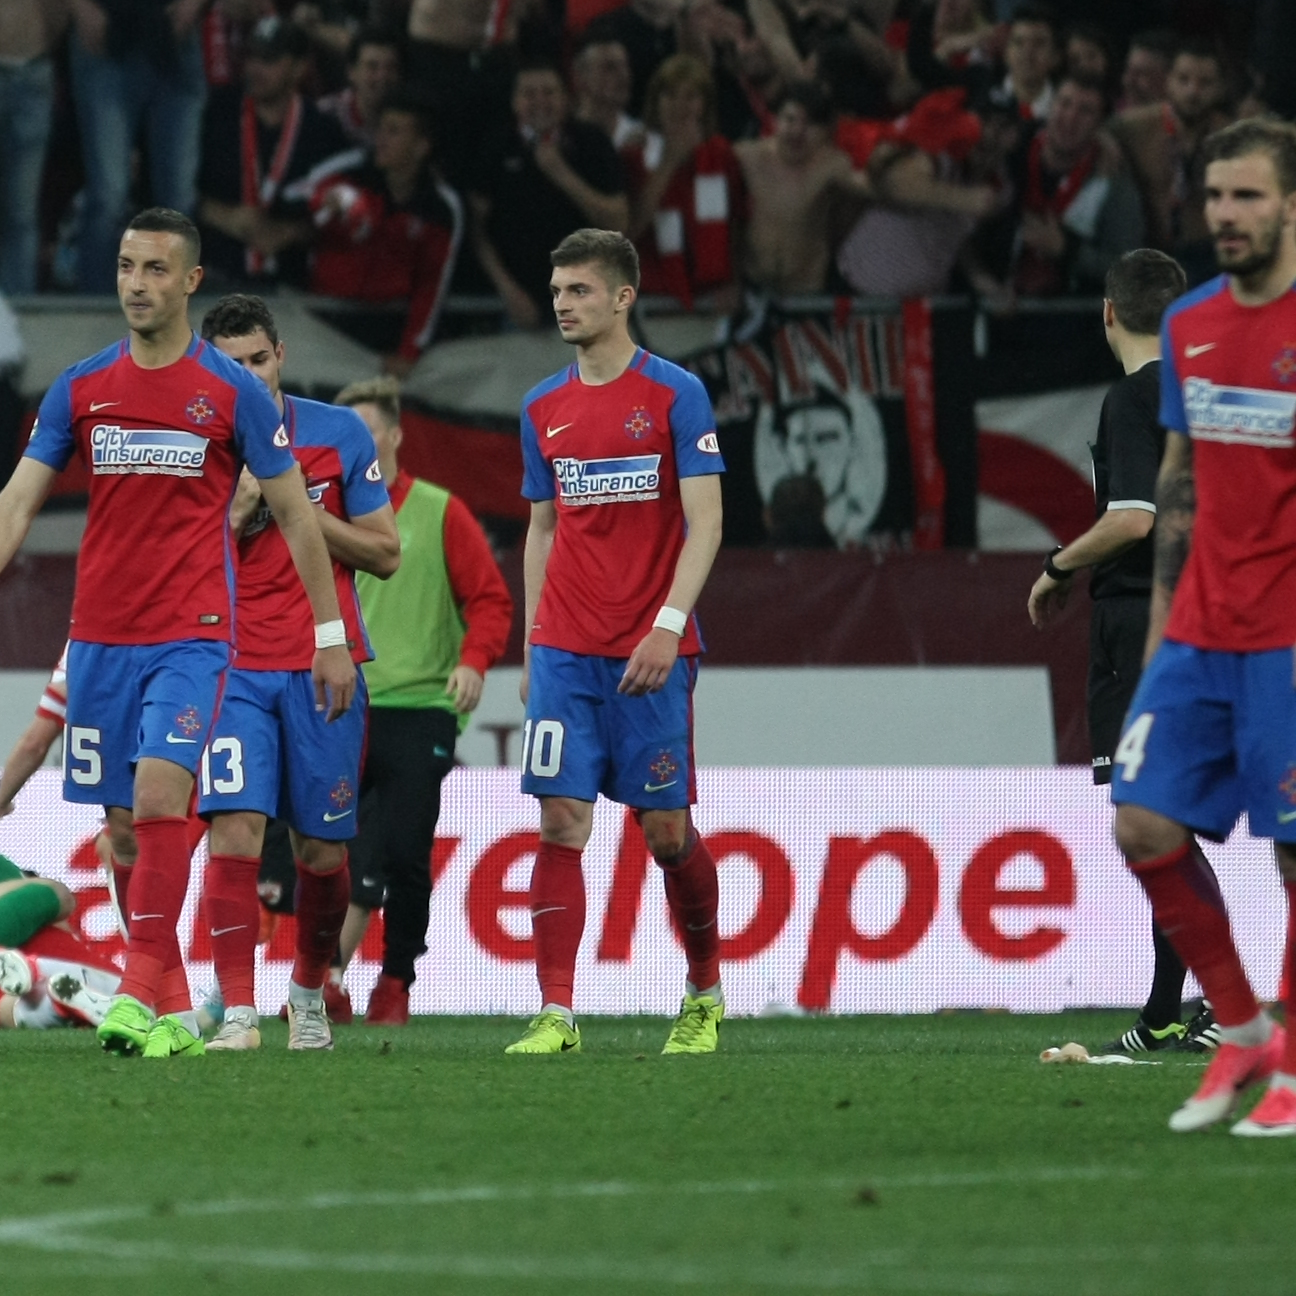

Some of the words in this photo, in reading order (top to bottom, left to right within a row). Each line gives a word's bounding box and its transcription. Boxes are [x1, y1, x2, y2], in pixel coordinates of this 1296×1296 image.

[91, 425, 131, 450] City
[101, 446, 204, 466] Insurance
[553, 459, 586, 482] City
[562, 473, 658, 495] Insurance
[521, 718, 565, 778] 10
[201, 736, 244, 796] 13
